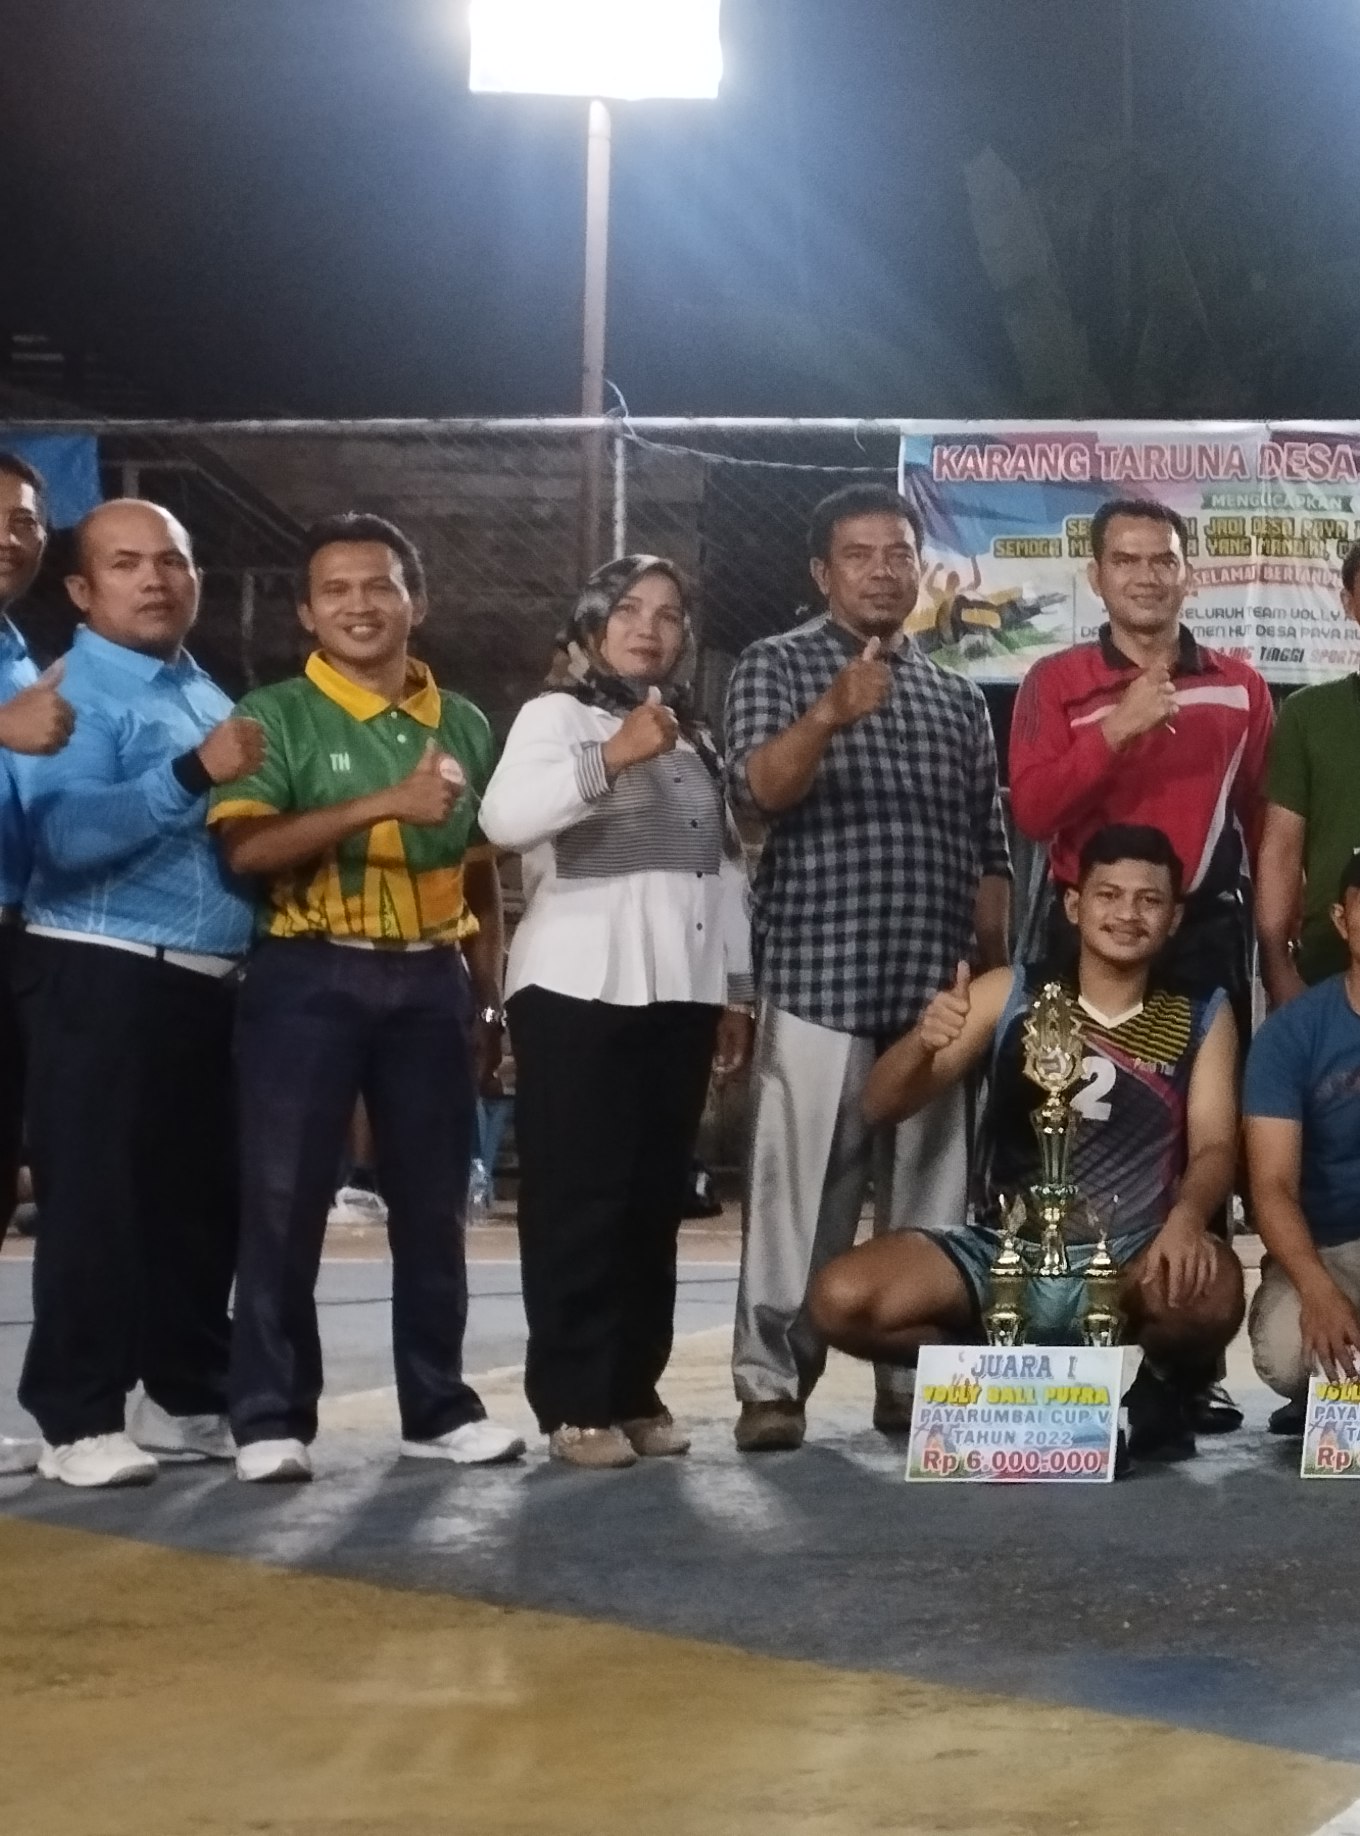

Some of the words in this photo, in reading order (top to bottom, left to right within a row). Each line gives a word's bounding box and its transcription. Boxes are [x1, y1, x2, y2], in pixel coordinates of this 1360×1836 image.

[933, 443, 1090, 481] KARANG
[1096, 444, 1249, 482] TARUNA
[1258, 443, 1357, 480] DESA
[994, 538, 1062, 558] SEMOGA
[1256, 625, 1297, 638] DESA
[330, 752, 350, 771] TH
[971, 1354, 1051, 1378] JUARA
[1067, 1355, 1077, 1379] I
[923, 1385, 981, 1405] VOLLY
[987, 1387, 1037, 1405] BALL
[1044, 1387, 1110, 1405] PUTRA
[920, 1409, 1043, 1424] PAYARUMBAI
[1051, 1409, 1090, 1424] CUP
[1099, 1410, 1109, 1423] V
[955, 1430, 1016, 1444] TAHUN
[1024, 1431, 1072, 1445] 2022
[923, 1451, 958, 1474] Rp
[966, 1451, 1100, 1471] 6.000.000
[1317, 1447, 1351, 1471] Rp
